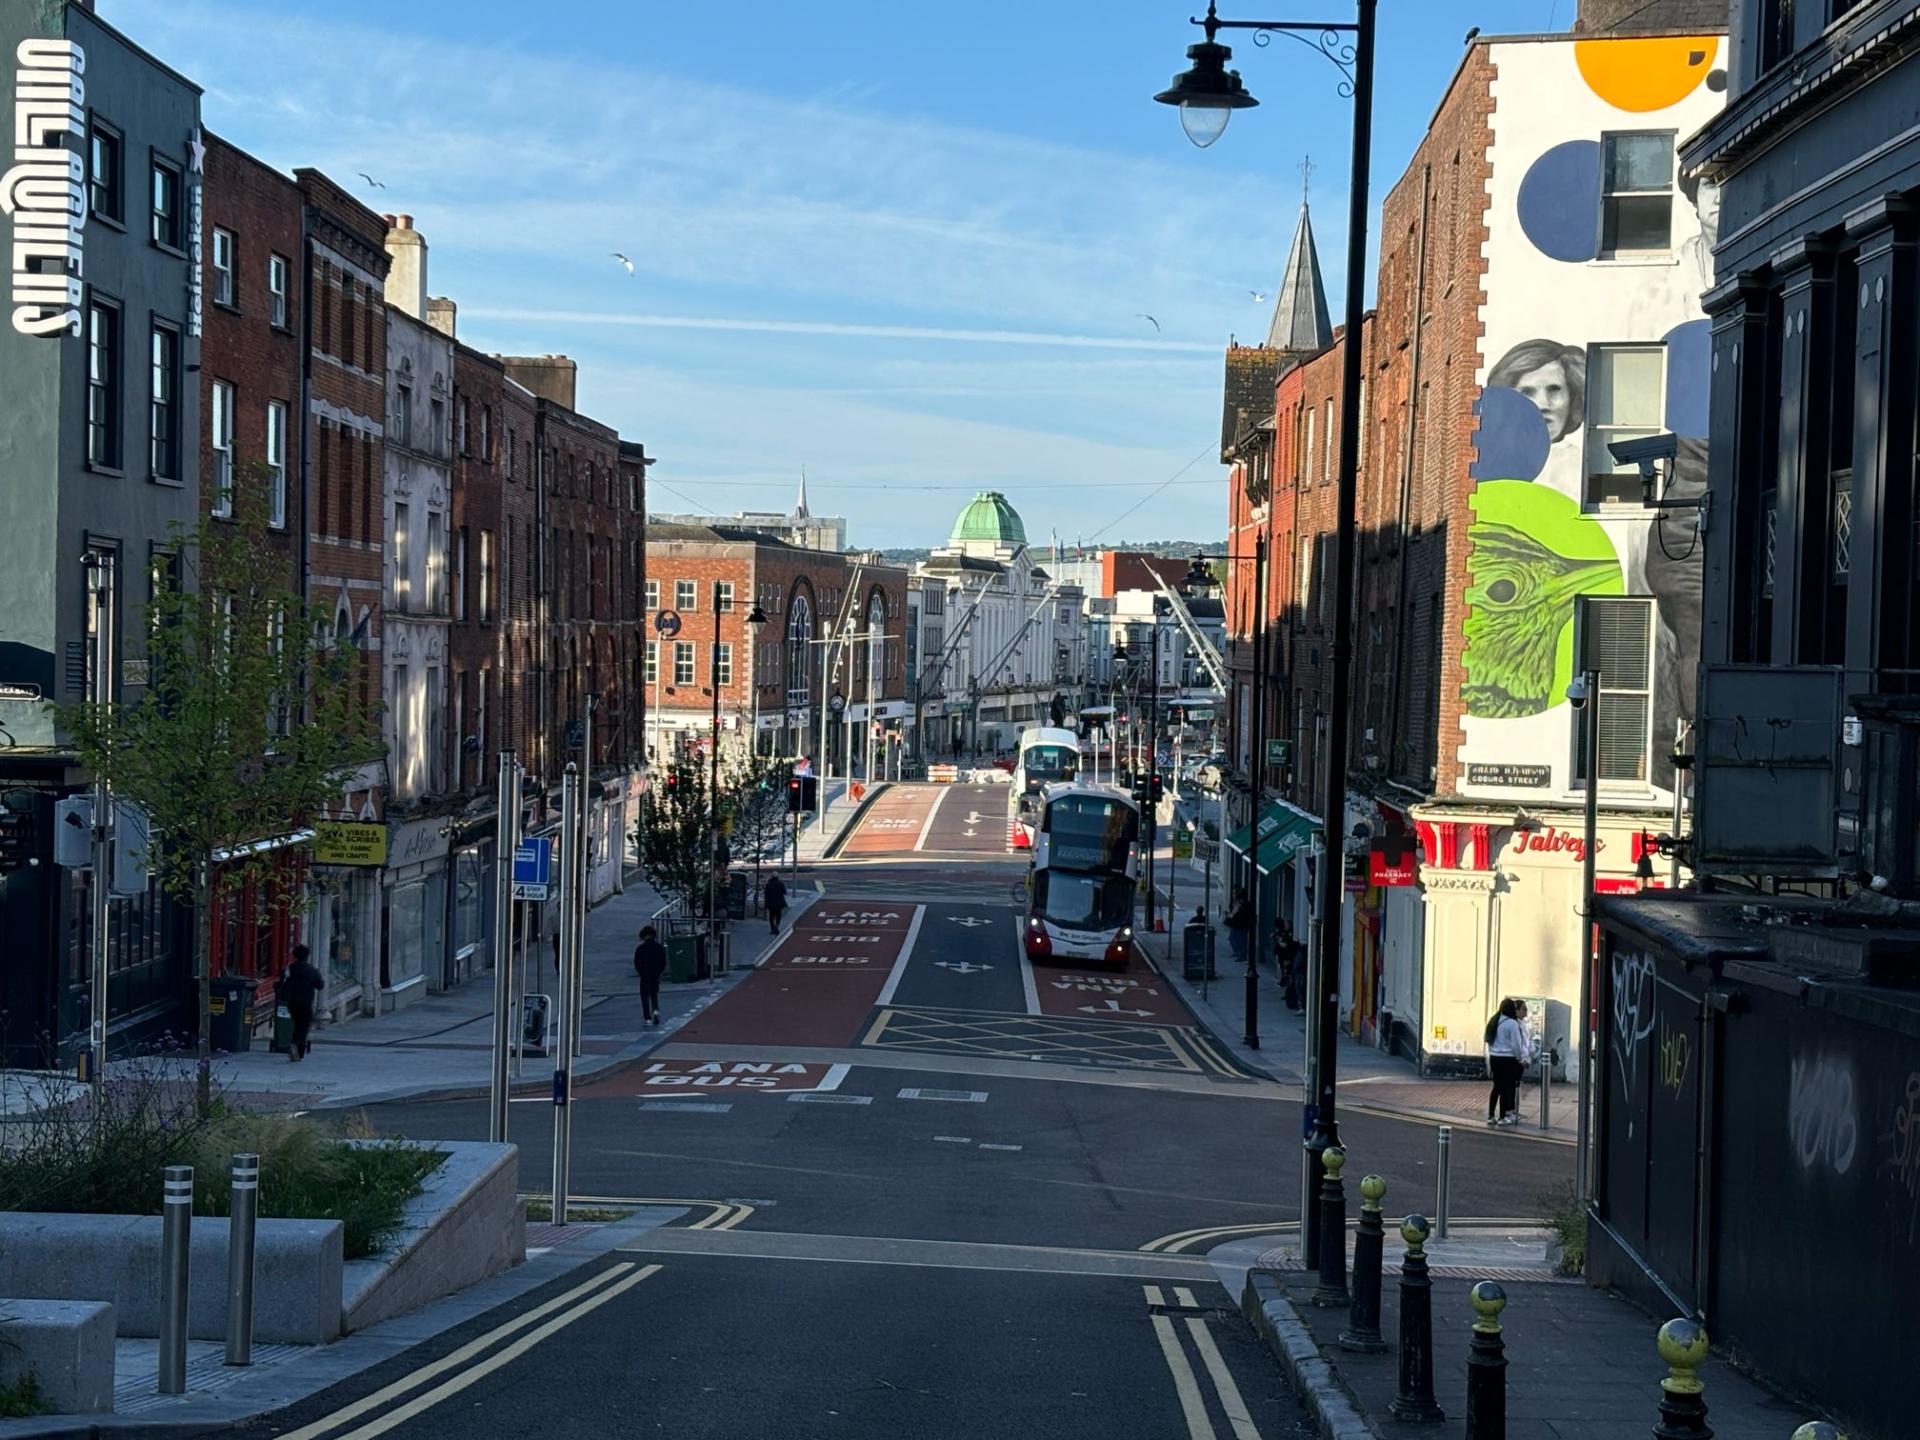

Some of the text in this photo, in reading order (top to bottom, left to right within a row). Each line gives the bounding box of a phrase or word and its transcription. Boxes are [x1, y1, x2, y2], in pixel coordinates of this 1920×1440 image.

[1, 38, 88, 338] GALLAGHERS
[1472, 775, 1539, 785] COBURG STREET
[644, 1075, 780, 1087] BUS
